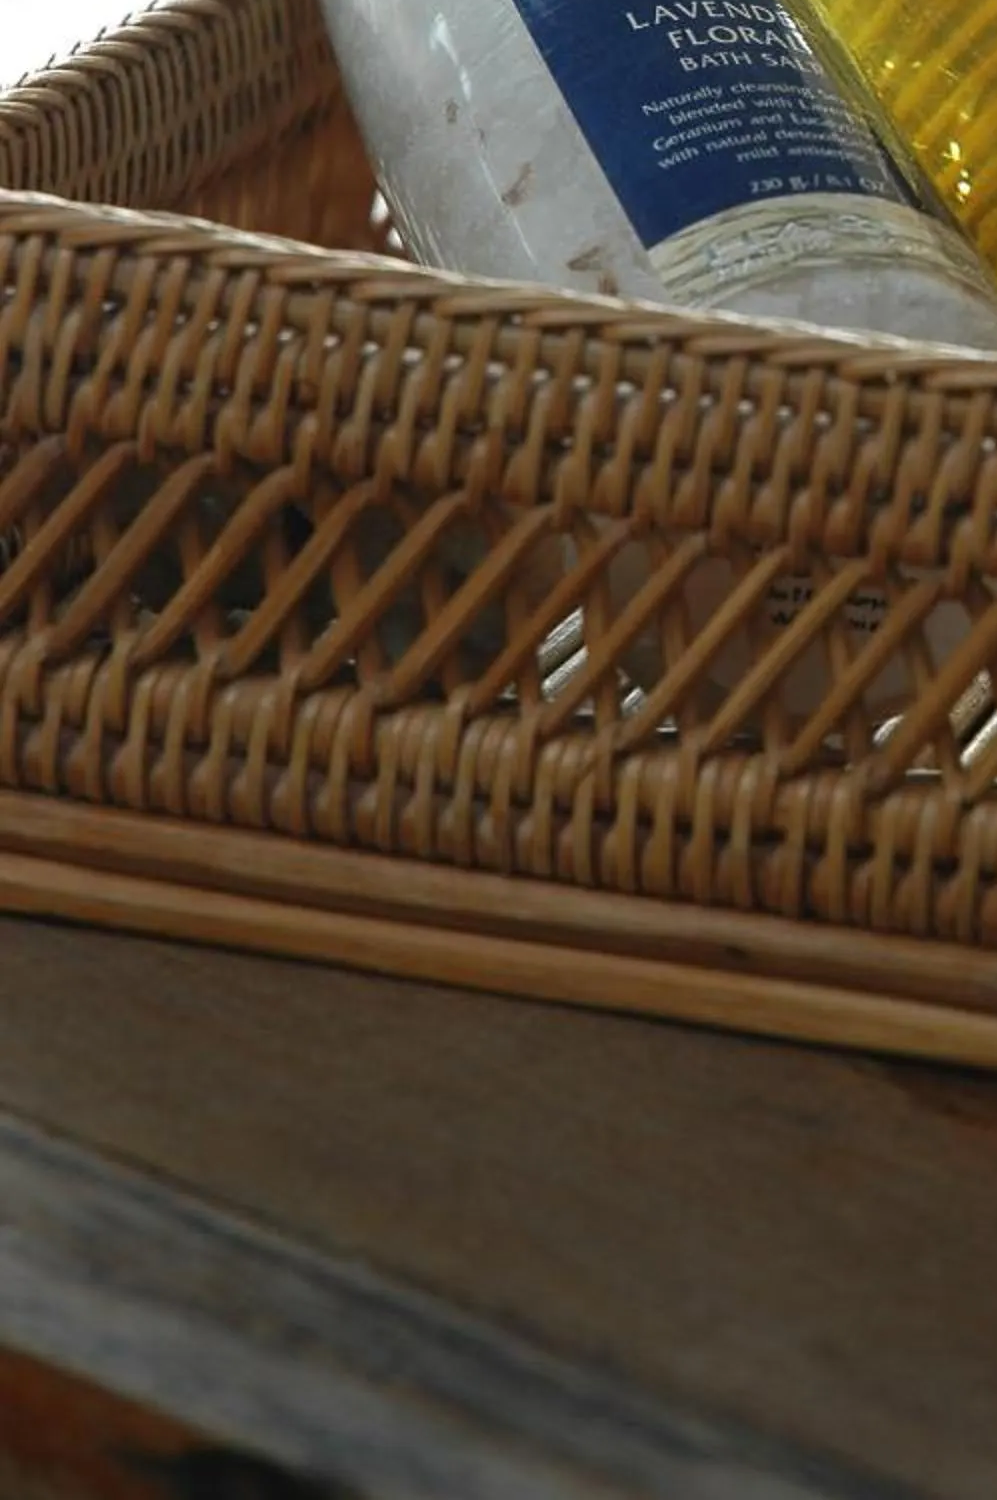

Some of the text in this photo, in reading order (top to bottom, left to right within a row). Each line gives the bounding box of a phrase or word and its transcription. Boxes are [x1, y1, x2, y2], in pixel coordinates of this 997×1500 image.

[679, 51, 752, 73] BATH
[642, 85, 722, 116] Naturally
[668, 97, 793, 125] blended with
[653, 118, 743, 151] Geranium
[750, 113, 781, 125] and
[657, 146, 700, 169] with
[705, 130, 768, 152] natural
